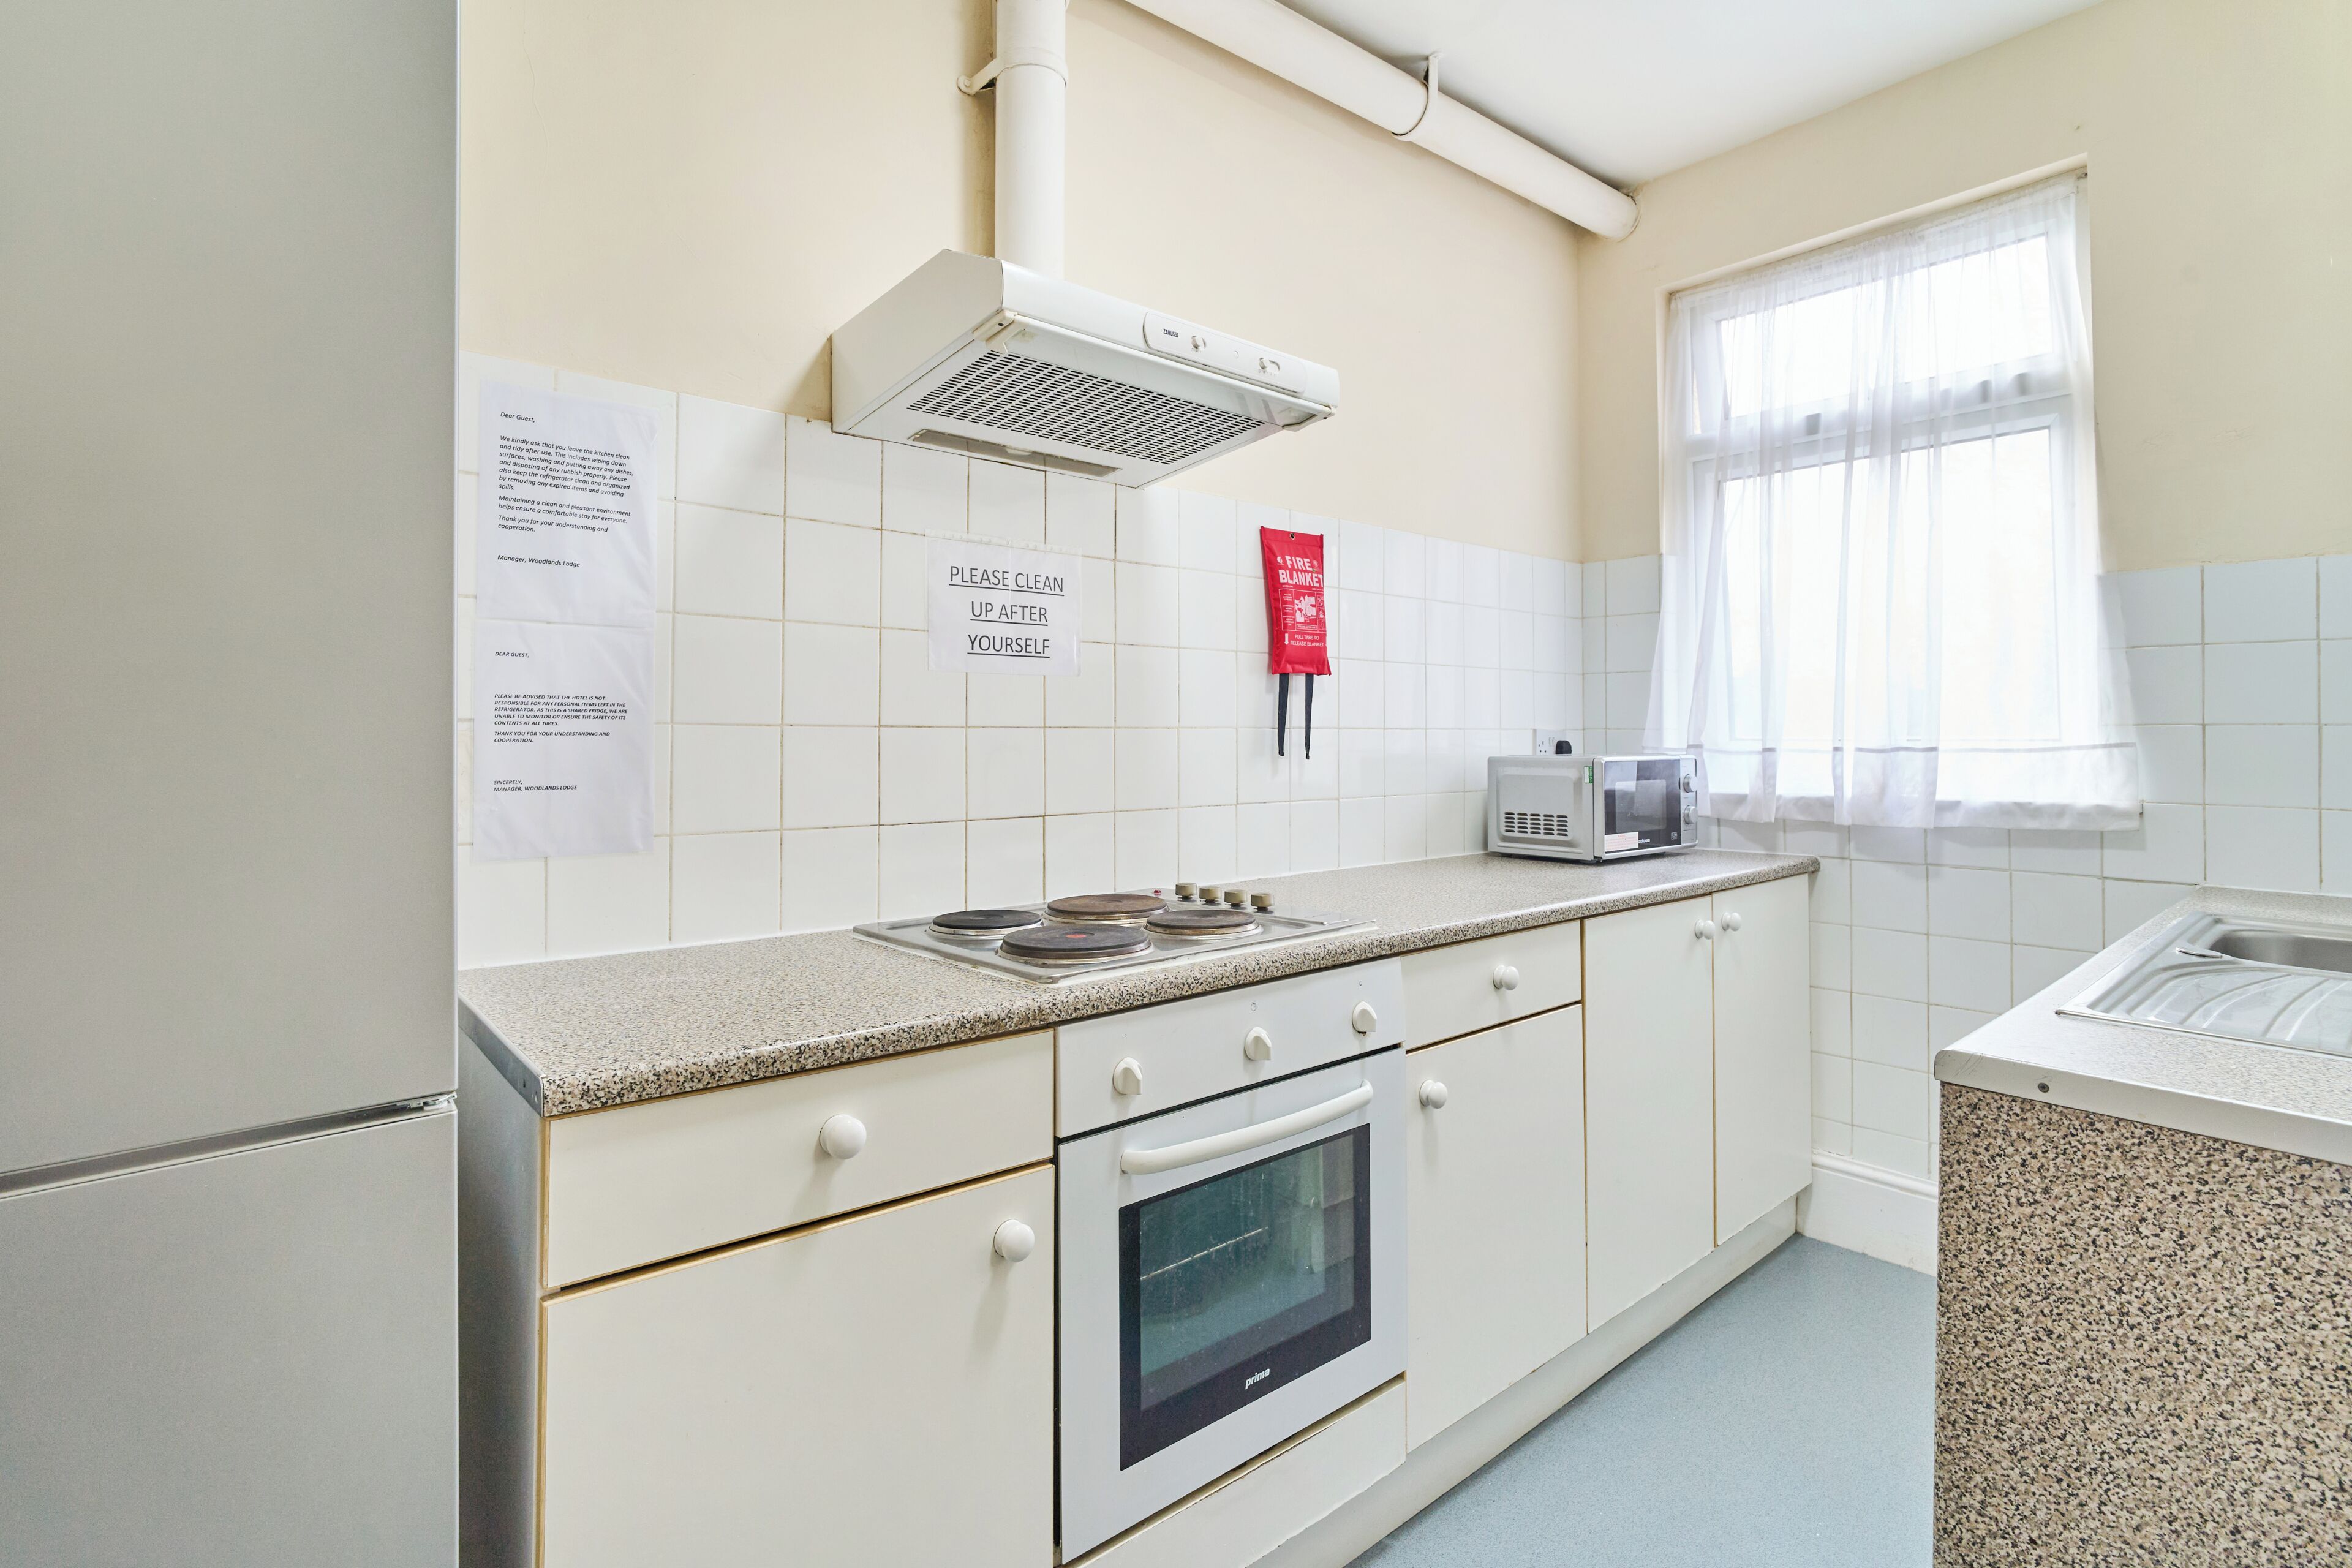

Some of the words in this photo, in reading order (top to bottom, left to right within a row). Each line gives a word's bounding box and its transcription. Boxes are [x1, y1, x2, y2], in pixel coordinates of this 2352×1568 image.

[1163, 328, 1178, 337] ZANUSSI
[513, 461, 540, 470] disposing
[540, 473, 573, 482] refrigerator
[600, 488, 624, 497] avoiding
[499, 496, 535, 505] Maintaining
[555, 522, 596, 532] understanding
[1285, 556, 1313, 571] FIRE
[950, 565, 1009, 587] PLEASE
[1015, 573, 1063, 592] CLEAN
[1279, 570, 1323, 587] BLANKET
[971, 601, 993, 618] UP
[998, 604, 1048, 622] AFTER
[968, 635, 1050, 654] YOURSELF
[1245, 1368, 1270, 1390] prima
